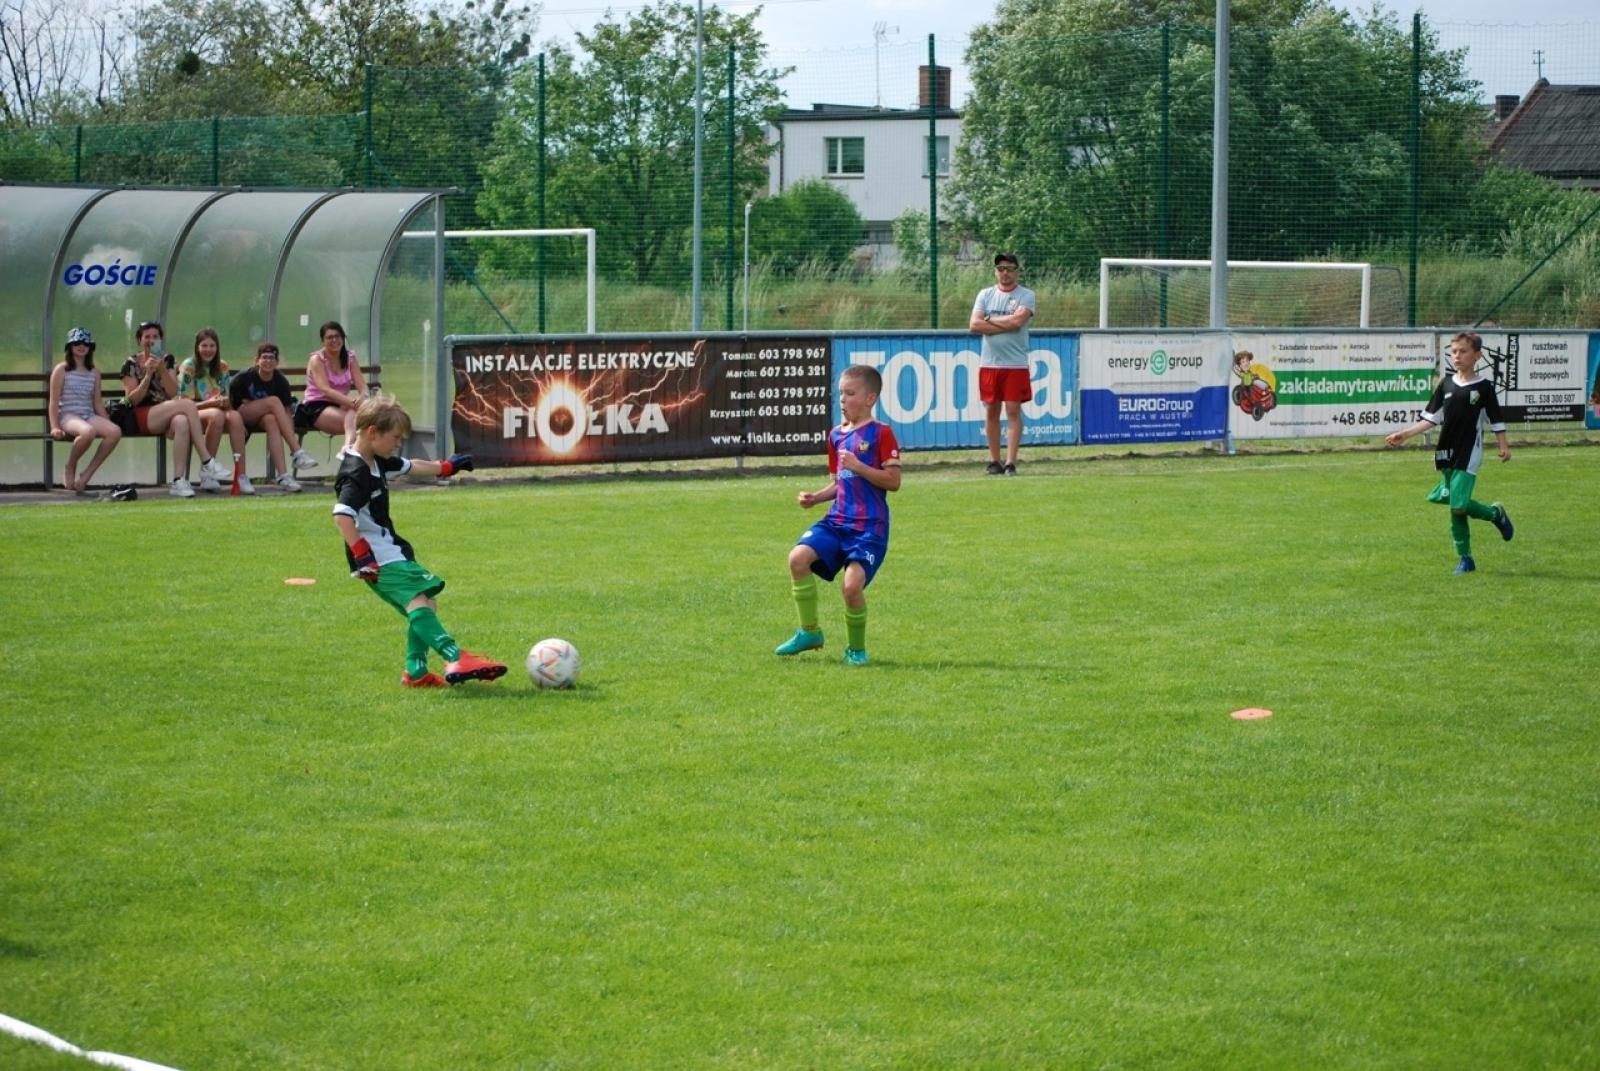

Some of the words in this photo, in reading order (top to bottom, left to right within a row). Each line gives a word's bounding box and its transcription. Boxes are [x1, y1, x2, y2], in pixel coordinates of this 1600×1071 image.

[64, 258, 158, 286] GOŚCIE
[758, 349, 780, 360] 603
[783, 349, 803, 360] 798
[806, 348, 826, 359] 967
[465, 353, 572, 373] INSTALACJE
[578, 351, 696, 370] ELEKTRYCZNE
[1108, 355, 1149, 370] energy
[1168, 354, 1204, 369] group
[759, 367, 780, 378] 607
[784, 366, 804, 377] 336
[807, 365, 826, 376] 321
[730, 391, 756, 400] Karol:
[758, 388, 780, 399] 603
[783, 388, 803, 398] 798
[806, 387, 826, 398] 977
[758, 406, 780, 417] 605
[782, 406, 803, 416] 083
[806, 405, 826, 415] 762
[1119, 398, 1194, 413] EUROGroup
[1332, 412, 1356, 425] +48
[1359, 411, 1380, 424] 668
[1383, 410, 1407, 424] 482
